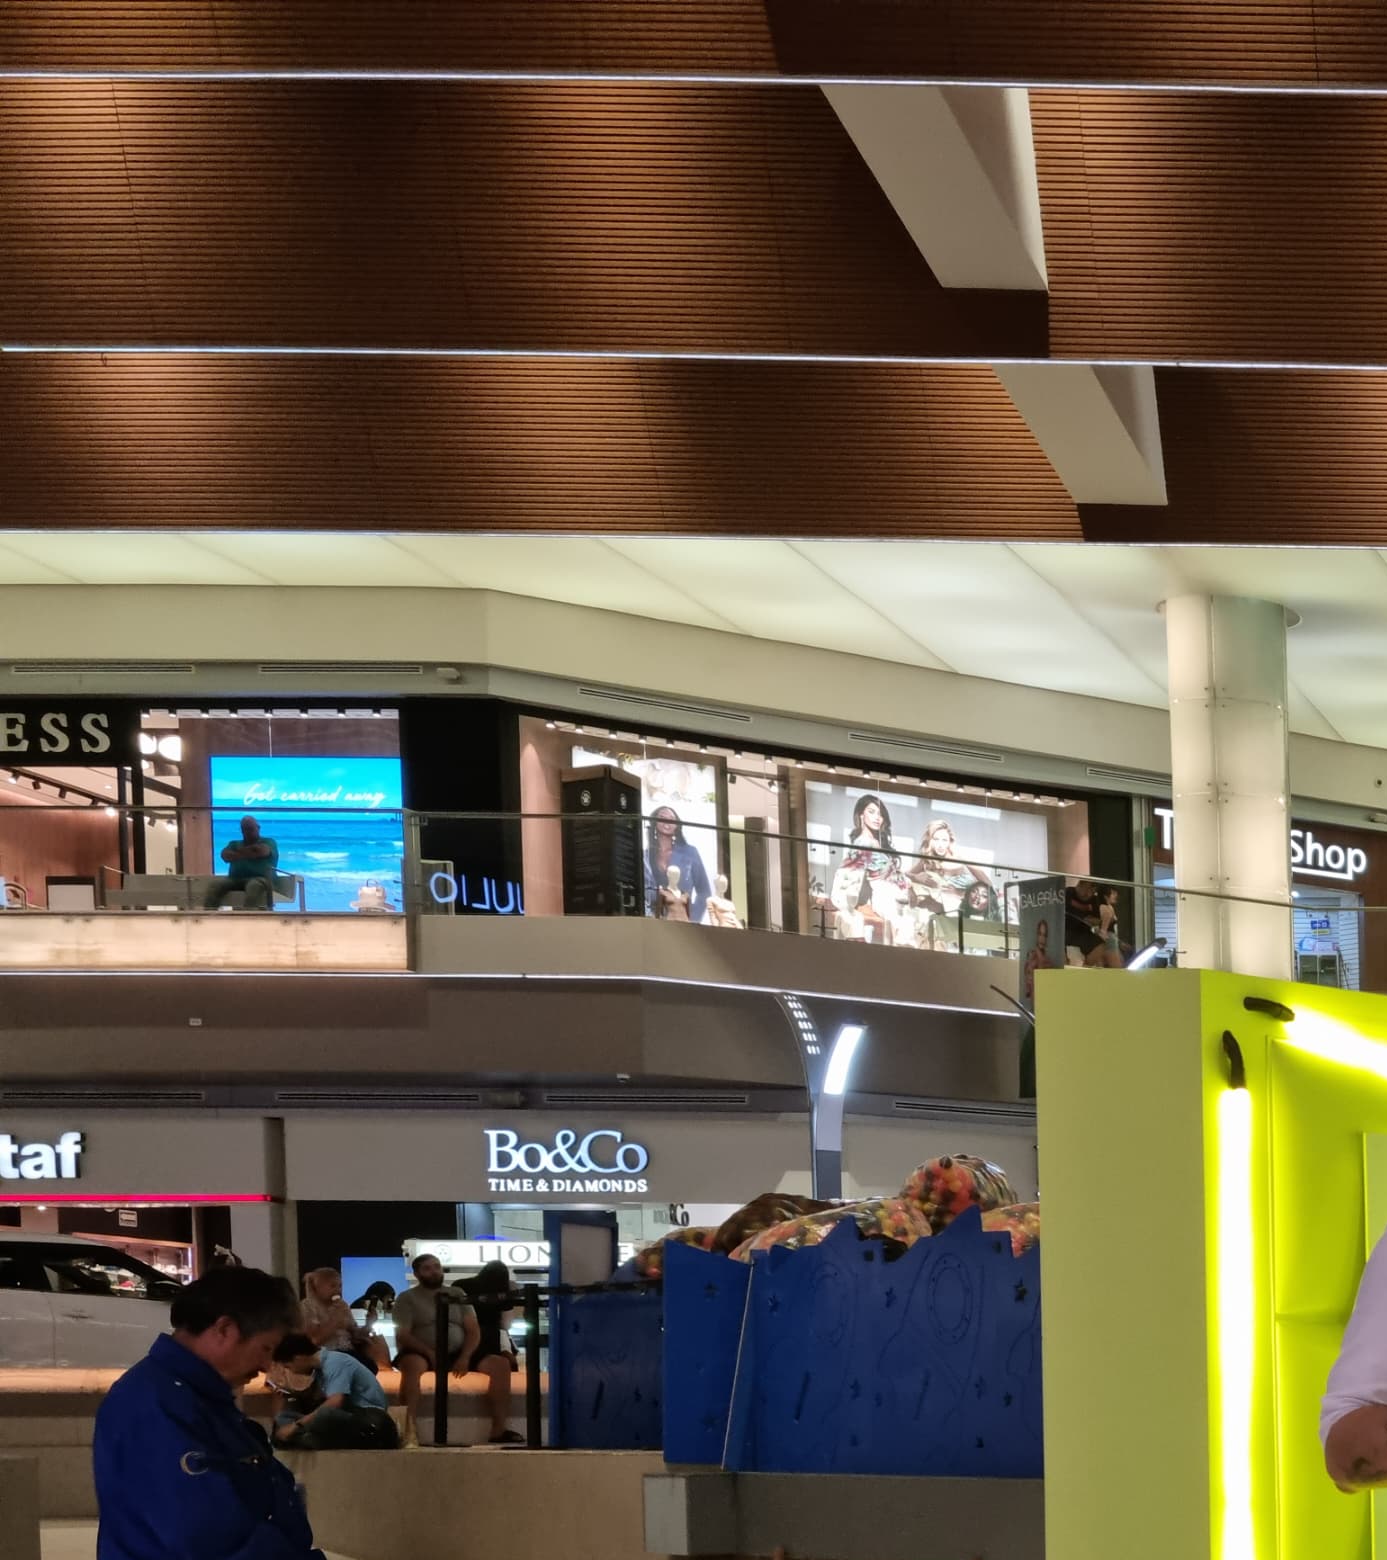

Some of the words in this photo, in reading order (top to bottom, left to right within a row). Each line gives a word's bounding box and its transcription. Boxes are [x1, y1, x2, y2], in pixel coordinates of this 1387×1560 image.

[1290, 830, 1367, 881] Shop
[484, 1129, 648, 1173] Bo&Co
[488, 1178, 533, 1192] TIME
[535, 1178, 549, 1192] &
[552, 1178, 648, 1193] DIAMONDS
